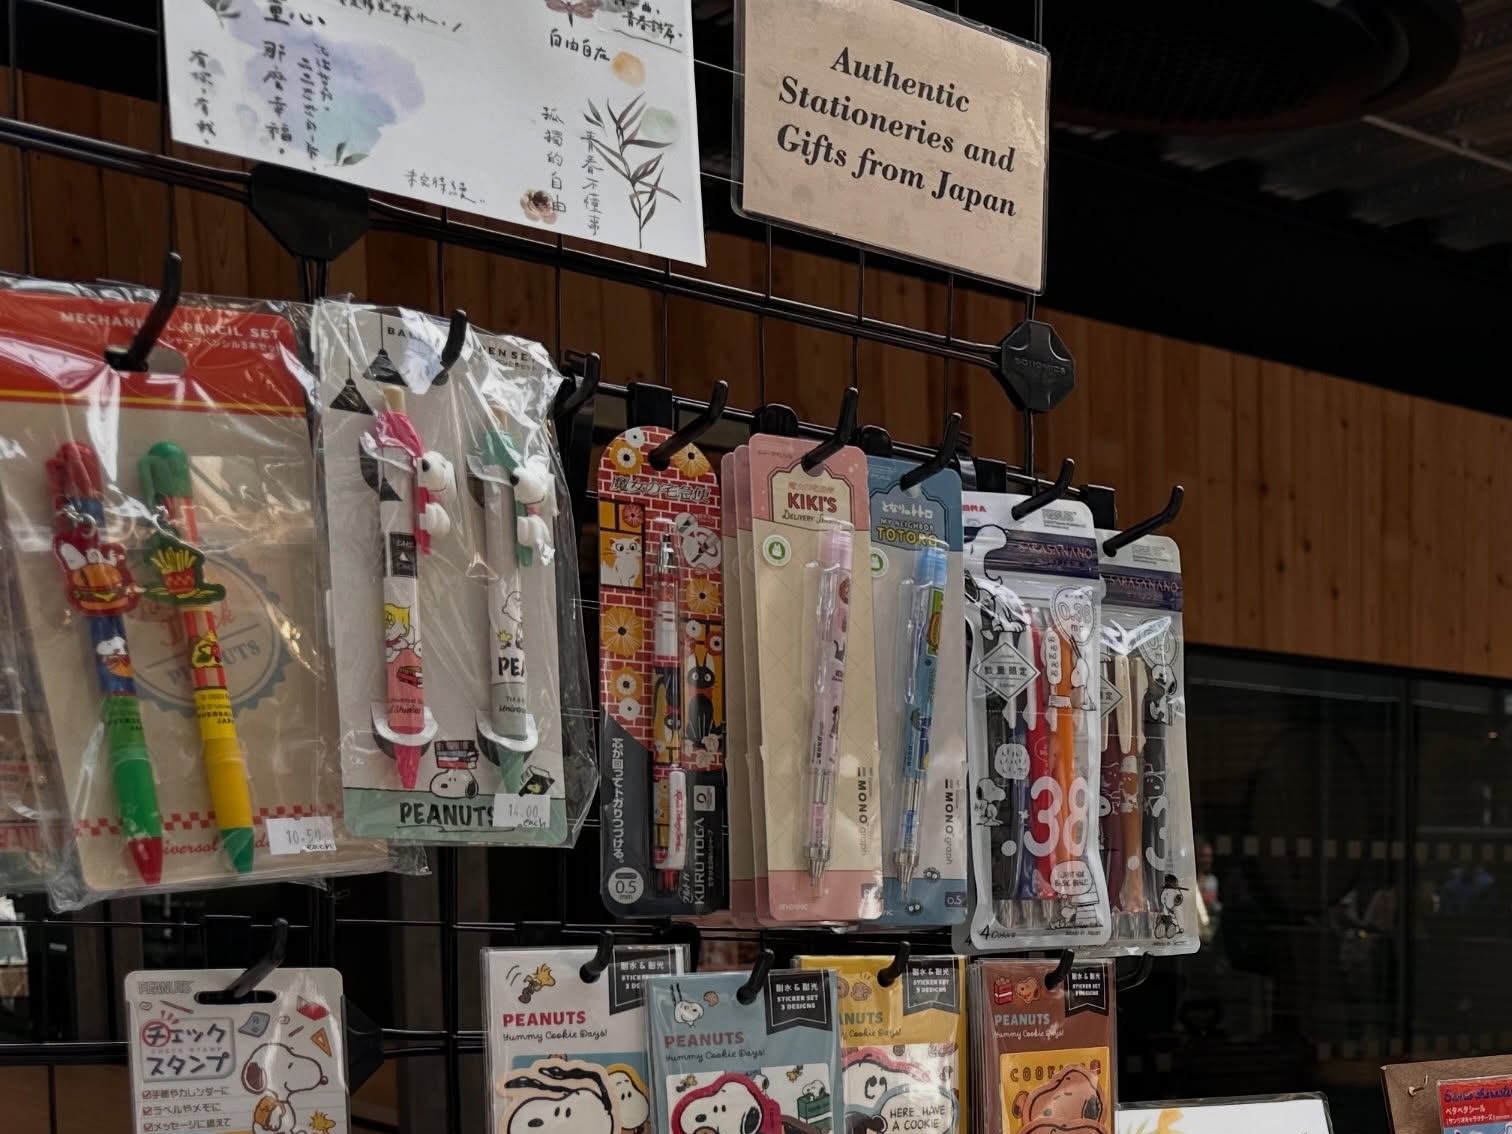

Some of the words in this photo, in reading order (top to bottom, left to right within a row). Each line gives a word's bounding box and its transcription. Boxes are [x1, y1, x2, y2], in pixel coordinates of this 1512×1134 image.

[549, 28, 611, 62] 自由自在
[829, 46, 970, 113] Authentic
[778, 75, 954, 153] Stationeries
[963, 146, 1017, 173] and
[777, 123, 847, 167] Gifts
[851, 148, 925, 189] from
[931, 170, 1016, 217] Japan
[60, 311, 175, 332] MECHANIL
[184, 322, 243, 338] PENCIL
[250, 328, 280, 340] SET
[787, 492, 838, 514] KIKI'S
[878, 527, 939, 546] TOTORO
[1057, 602, 1092, 624] 0.38
[984, 664, 1029, 678] 数量限定
[399, 801, 496, 828] PEANUTS
[614, 881, 639, 895] 0.5
[946, 895, 964, 906] 0.5
[503, 1010, 587, 1028] PEANUTS
[993, 1013, 1051, 1026] PEANUTS
[147, 1022, 227, 1046] チェック
[503, 1032, 543, 1043] Yummy
[545, 1030, 578, 1041] Cookie
[579, 1029, 608, 1041] Days!
[664, 1031, 744, 1049] PEANUTS
[146, 1052, 230, 1076] スタンプ
[665, 1051, 704, 1063] Yummy
[706, 1050, 735, 1061] Cookie
[736, 1047, 766, 1060] Days!
[889, 1106, 915, 1119] HERE
[922, 1104, 946, 1117] HAVE
[892, 1120, 901, 1131] A
[903, 1118, 940, 1130] COOKIE
